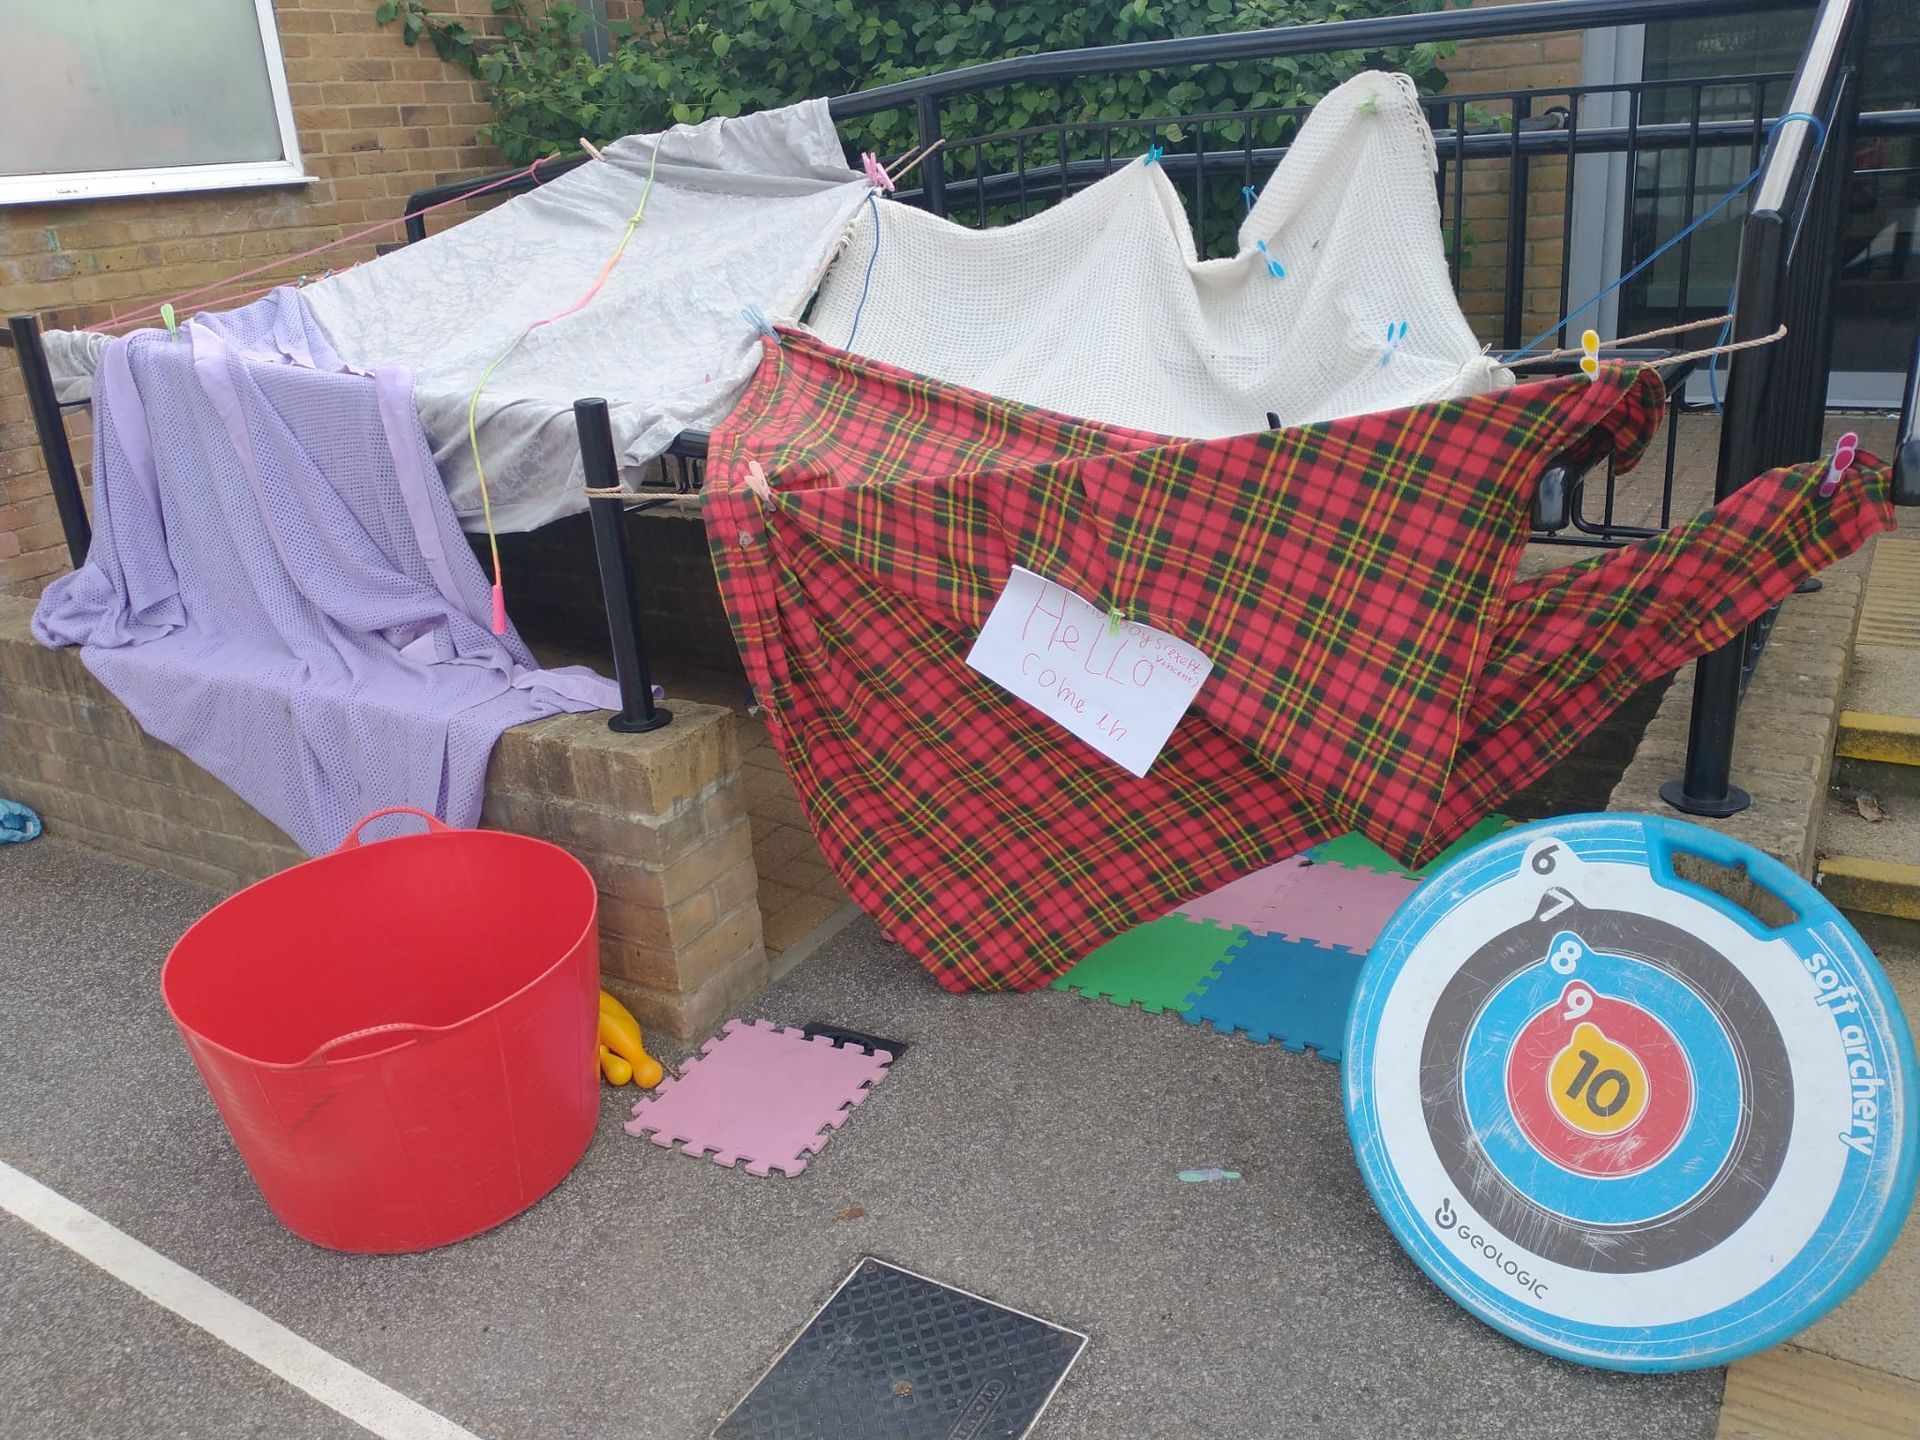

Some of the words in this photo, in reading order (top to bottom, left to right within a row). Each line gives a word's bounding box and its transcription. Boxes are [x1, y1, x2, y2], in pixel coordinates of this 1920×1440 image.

[1022, 652, 1084, 714] come
[1096, 713, 1128, 742] in
[1531, 843, 1561, 876] 6
[1539, 887, 1575, 923] 7
[1550, 940, 1583, 975] 8
[1562, 988, 1594, 1021] 9
[1803, 952, 1860, 1017] soft
[1838, 1024, 1886, 1156] archery
[1565, 1049, 1631, 1118] 10
